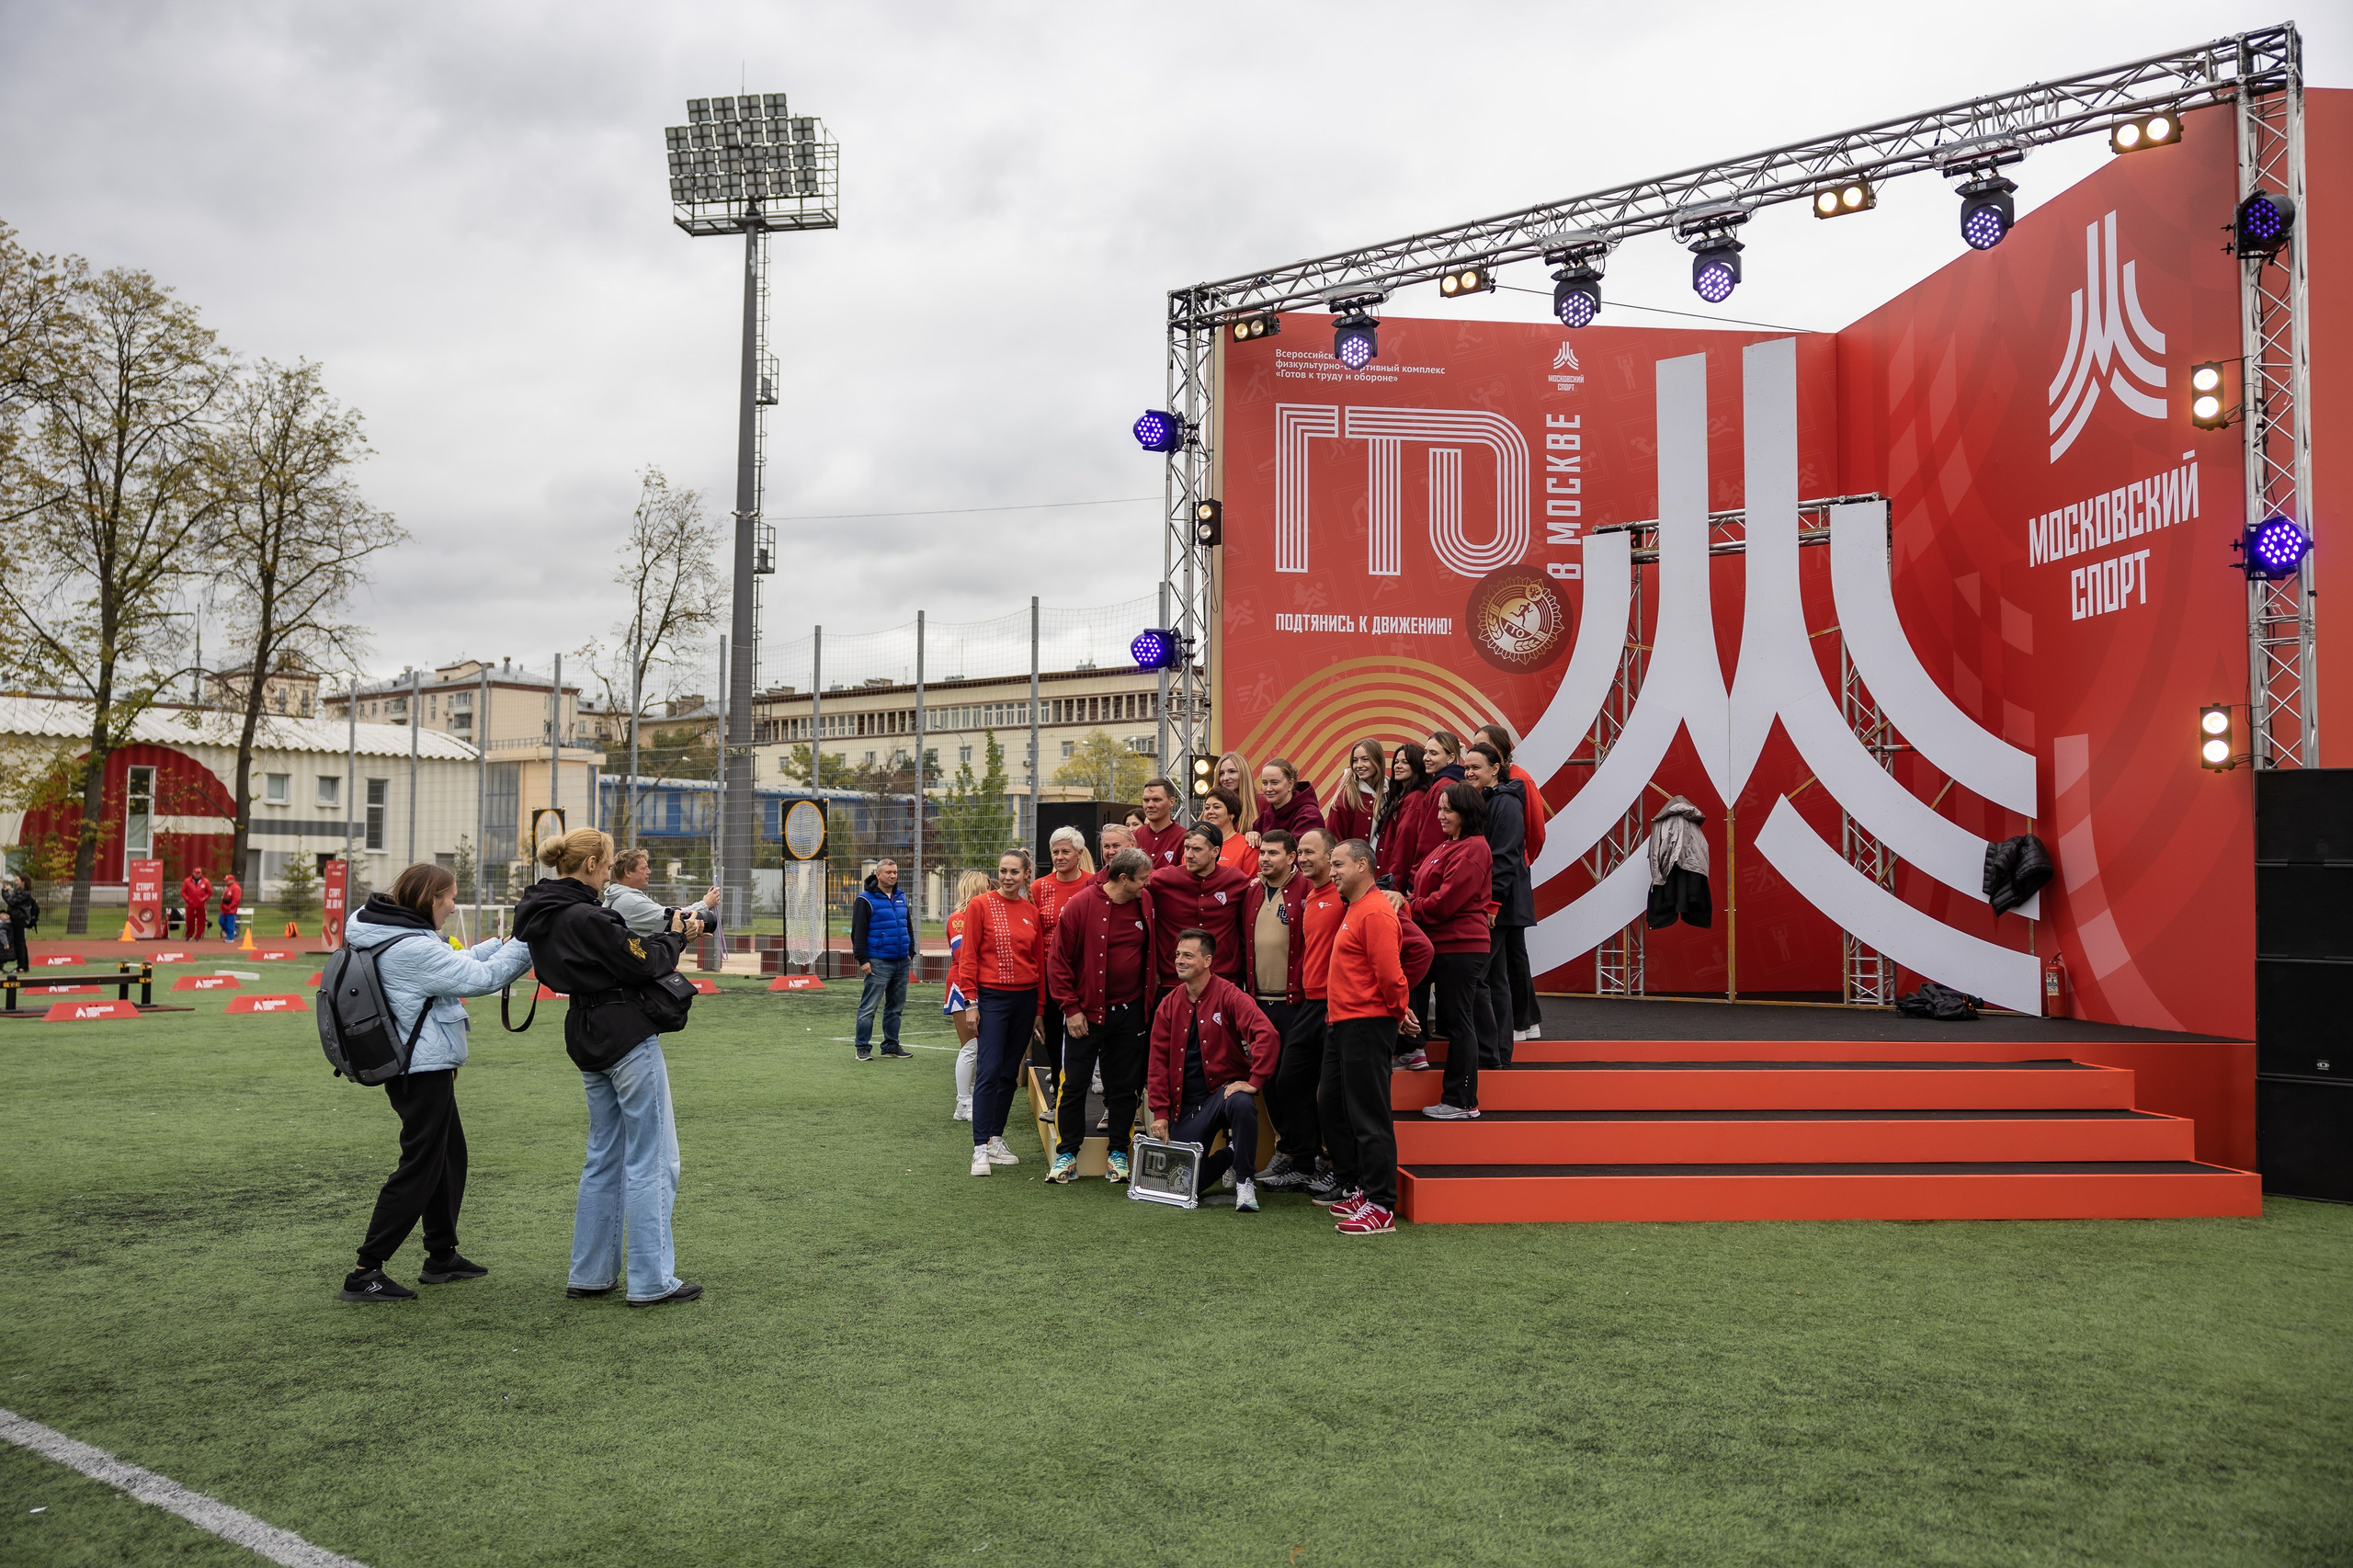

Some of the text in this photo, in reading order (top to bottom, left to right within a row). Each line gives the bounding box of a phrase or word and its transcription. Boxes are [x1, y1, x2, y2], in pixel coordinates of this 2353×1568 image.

[1275, 369, 1306, 379] «Готов
[1316, 372, 1343, 381] труду
[1354, 372, 1399, 383] обороне»
[1402, 366, 1446, 375] комплекс
[1548, 374, 1585, 383] МОСКОВСКИЙ
[1557, 382, 1575, 392] СПОРТ
[1275, 403, 1530, 579] ГТО
[1546, 414, 1582, 580] В МОСКВЕ
[2029, 449, 2200, 568] МОСКОВСКИЙ
[2071, 548, 2151, 621] СПОРТ
[1275, 613, 1452, 635] ПОДТЯНИСЬ К ДВИЖЕНИЮ!
[1504, 620, 1525, 638] ГТО
